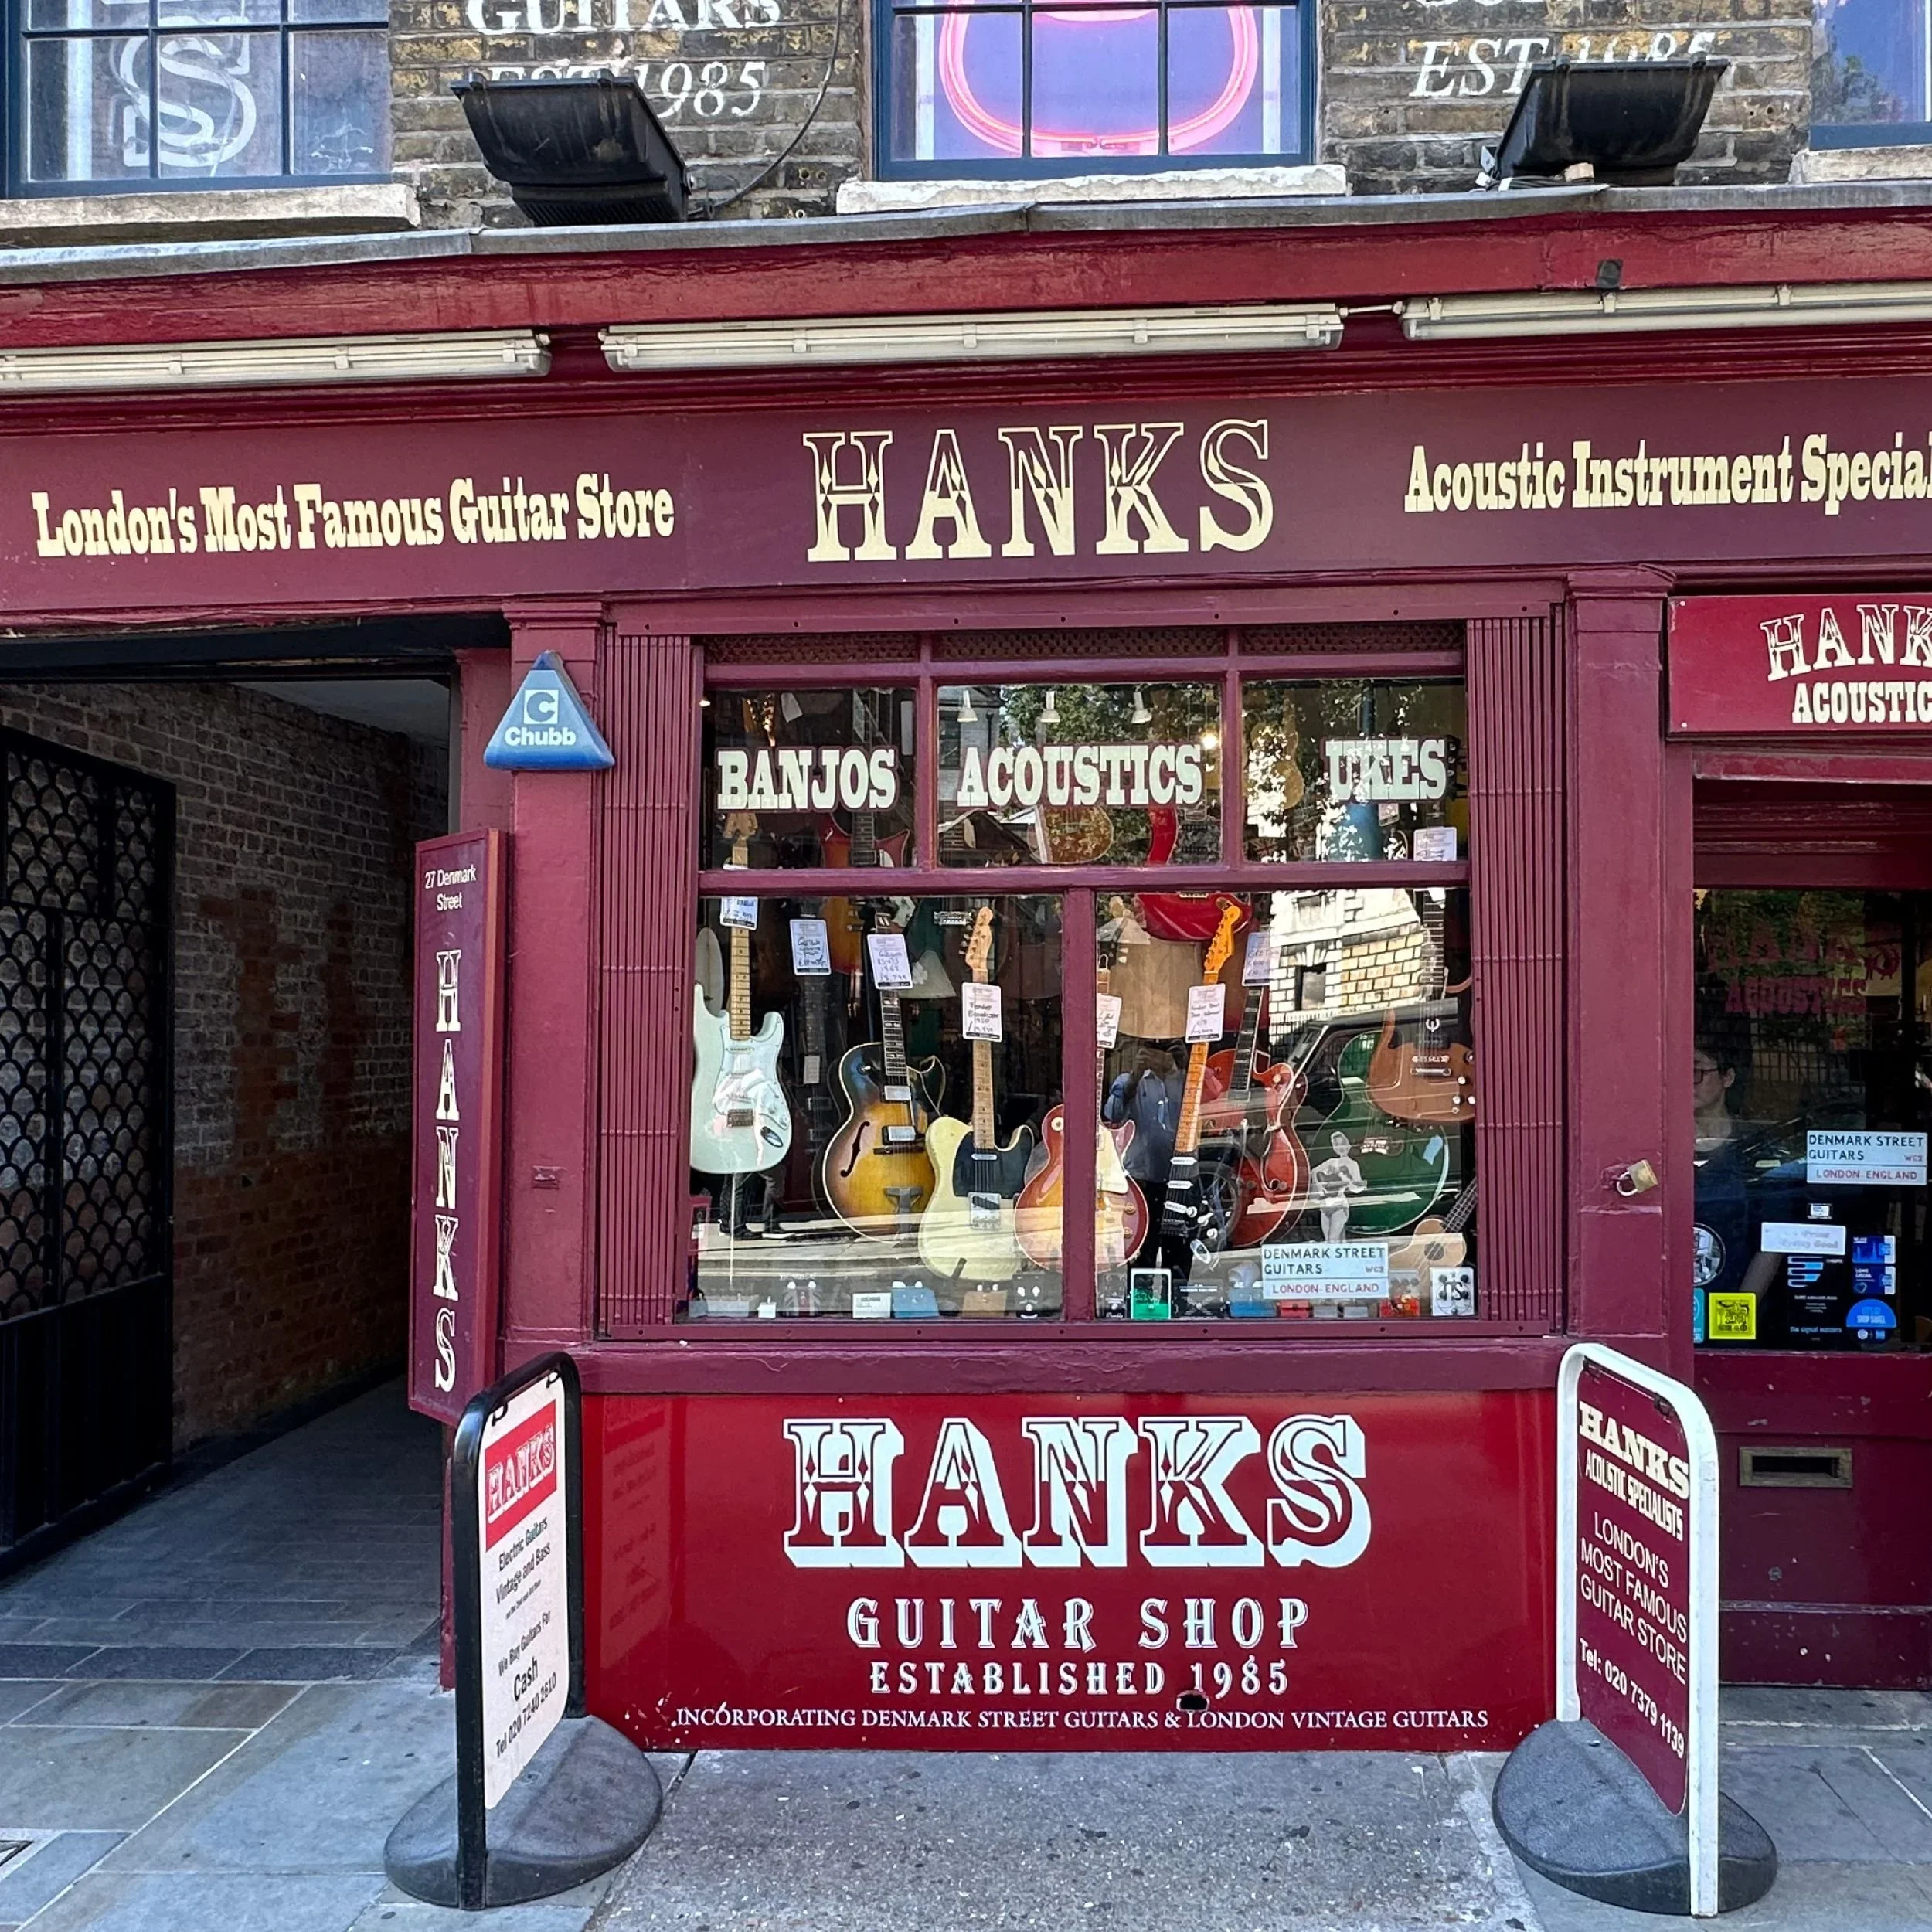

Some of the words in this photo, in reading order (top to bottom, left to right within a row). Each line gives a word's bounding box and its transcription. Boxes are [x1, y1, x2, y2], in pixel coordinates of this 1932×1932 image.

[802, 418, 1274, 562] HANKS
[1404, 442, 1566, 512] Acoustic
[1572, 434, 1794, 509] Instrument
[31, 488, 197, 557] London's
[200, 485, 291, 552] Most
[294, 482, 445, 549] Famous
[449, 476, 570, 545] Guitar
[575, 471, 675, 539] Store
[1792, 680, 1932, 724] ACOUSTIC
[505, 727, 576, 746] Chubb
[716, 748, 897, 811] BANJOS
[957, 744, 1202, 807] ACOUSTICS
[1325, 739, 1447, 803] UKES
[425, 872, 436, 889] 27
[437, 864, 476, 887] Denmark
[437, 893, 463, 912] Street
[433, 949, 461, 1393] HANKS
[1808, 1134, 1872, 1146] DENMARK
[1876, 1135, 1924, 1147] STREET
[1808, 1149, 1864, 1161] GUITARS
[1816, 1168, 1860, 1179] LONDON
[1866, 1170, 1917, 1180] ENGLAND
[1264, 1247, 1331, 1259] DENMARK
[1335, 1247, 1386, 1258] STREET
[1264, 1264, 1323, 1274] GUITARS
[1272, 1284, 1319, 1294] LONDON
[1325, 1283, 1379, 1294] ENGLAND
[487, 1422, 555, 1524] HANKS
[1579, 1400, 1689, 1499] HANKS
[783, 1413, 1372, 1569] HANKS
[1586, 1448, 1626, 1502] ACOUSTIC
[1628, 1474, 1683, 1542] SPECIALISTS
[496, 1570, 522, 1604] Vintage
[523, 1553, 535, 1579] and
[536, 1543, 551, 1566] Bass
[499, 1537, 524, 1572] Electric
[526, 1517, 547, 1546] Guitars
[1594, 1512, 1669, 1588] LONDON'S
[1581, 1537, 1622, 1587] MOST
[1625, 1572, 1686, 1644] FAMOUS
[498, 1657, 508, 1676] We
[509, 1645, 520, 1665] Buy
[521, 1621, 541, 1651] Guitars
[846, 1597, 1097, 1653] GUITAR
[1138, 1597, 1308, 1648] SHOP
[1580, 1573, 1634, 1636] GUITAR
[1638, 1617, 1686, 1685] STORE
[514, 1656, 538, 1701] Cash
[869, 1661, 1165, 1695] ESTABLISHED
[1190, 1656, 1289, 1699] 1985
[1580, 1638, 1601, 1675] Tel:
[1604, 1658, 1627, 1696] 020
[1630, 1680, 1658, 1726] 7379
[1659, 1712, 1684, 1759] 1139
[496, 1731, 507, 1758] Tel
[509, 1714, 522, 1743] 020
[522, 1693, 539, 1725] 7240
[862, 1709, 971, 1728] DENMARK
[978, 1709, 1058, 1728] STREET
[1064, 1710, 1158, 1729] GUITARS
[1164, 1711, 1181, 1728] &
[1187, 1710, 1284, 1729] LONDON
[1292, 1710, 1386, 1729] VINTAGE
[1393, 1710, 1488, 1729] GUITARS
